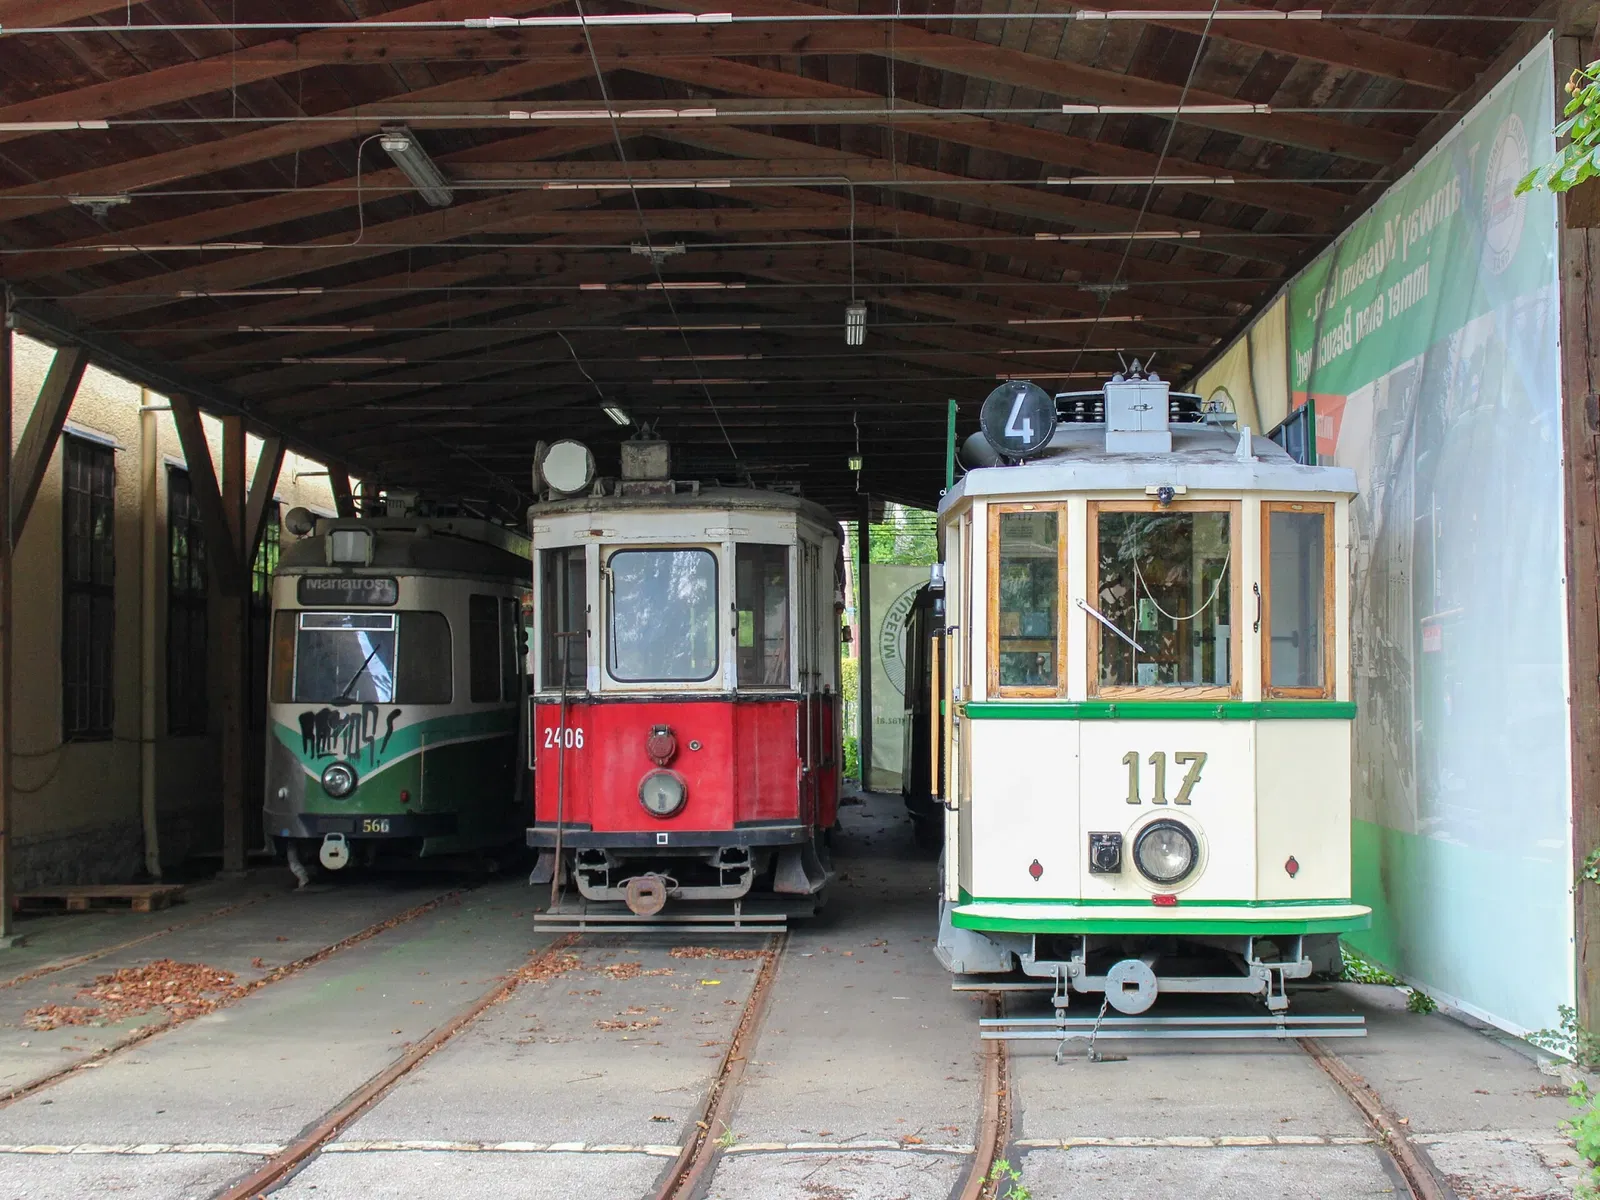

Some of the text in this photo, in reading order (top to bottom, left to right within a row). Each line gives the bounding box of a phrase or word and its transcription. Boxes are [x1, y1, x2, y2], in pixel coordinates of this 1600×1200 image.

[1003, 392, 1035, 444] 4
[544, 727, 584, 749] 2406
[1122, 751, 1208, 805] 117
[362, 818, 390, 833] 566
